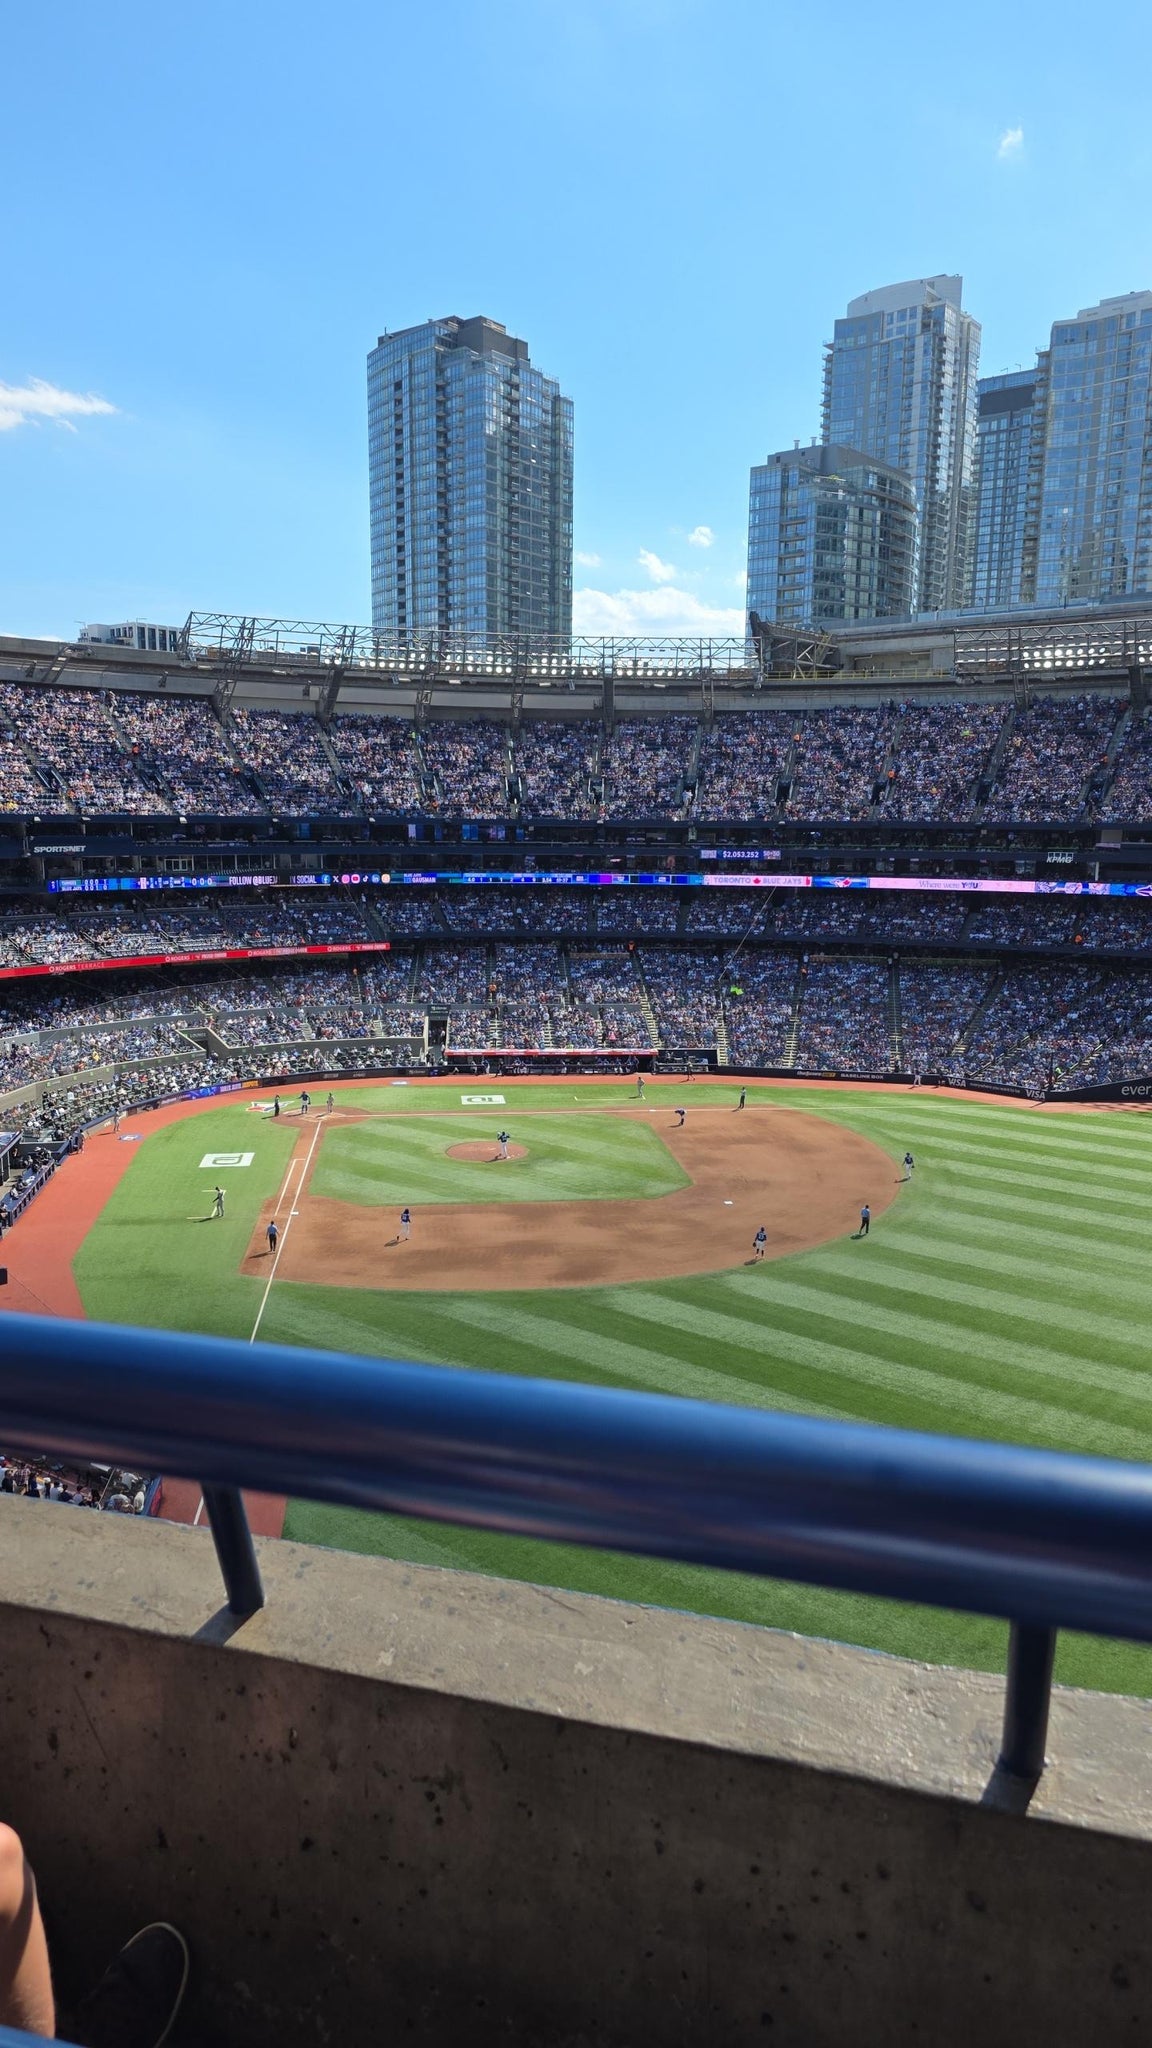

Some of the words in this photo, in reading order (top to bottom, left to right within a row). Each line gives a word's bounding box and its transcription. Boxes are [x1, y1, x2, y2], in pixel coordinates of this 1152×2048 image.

[34, 845, 86, 853] SPORTSNET
[229, 876, 252, 885] FOLLOW
[296, 875, 317, 883] SOCIAL
[713, 876, 751, 884] TORONTO
[762, 876, 781, 884] BLUE
[783, 877, 802, 885] JAYS
[919, 880, 940, 888] Where
[55, 964, 76, 972] ROGERS
[947, 1077, 966, 1088] VISA
[1025, 1089, 1045, 1099] VISA
[1121, 1085, 1152, 1097] ever
